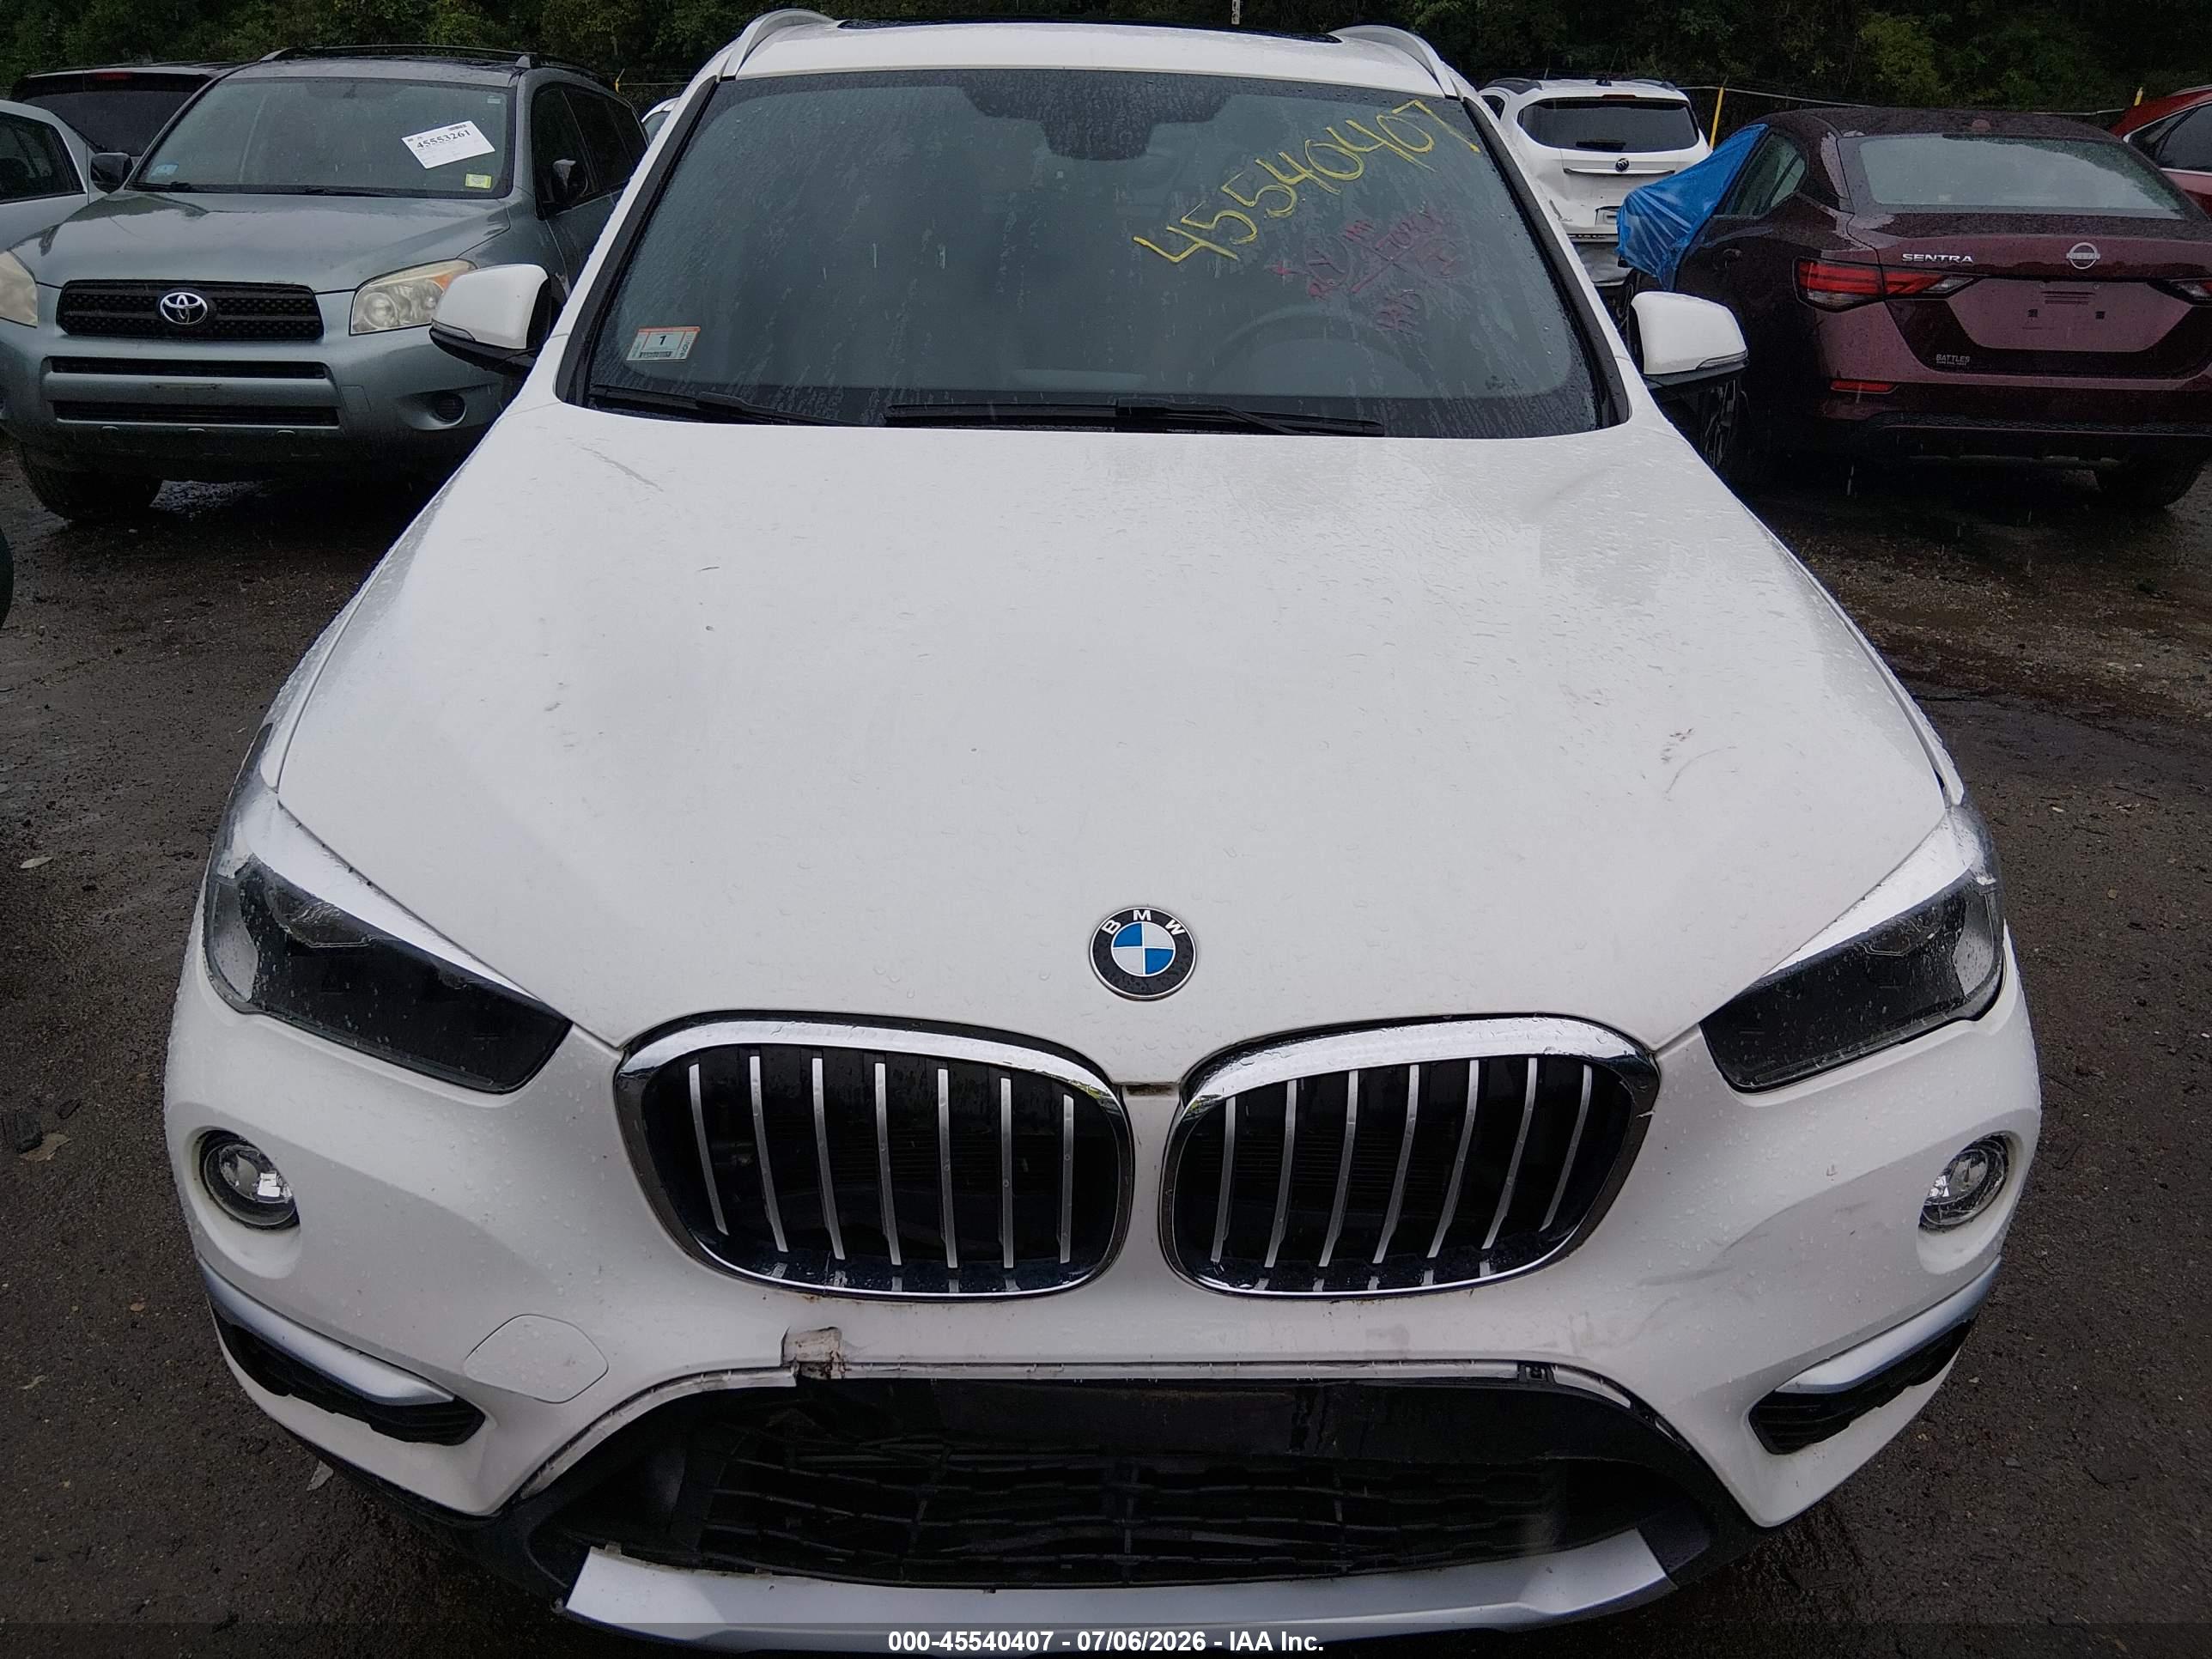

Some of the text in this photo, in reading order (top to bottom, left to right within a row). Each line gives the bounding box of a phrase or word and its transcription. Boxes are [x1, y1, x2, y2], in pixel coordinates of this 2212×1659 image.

[416, 129, 471, 149] 45553261
[1133, 99, 1481, 264] 45540407
[1901, 253, 1974, 264] SENTRA
[659, 335, 667, 346] 1
[1936, 354, 1971, 363] BATTLES
[1101, 909, 1186, 936] BMW
